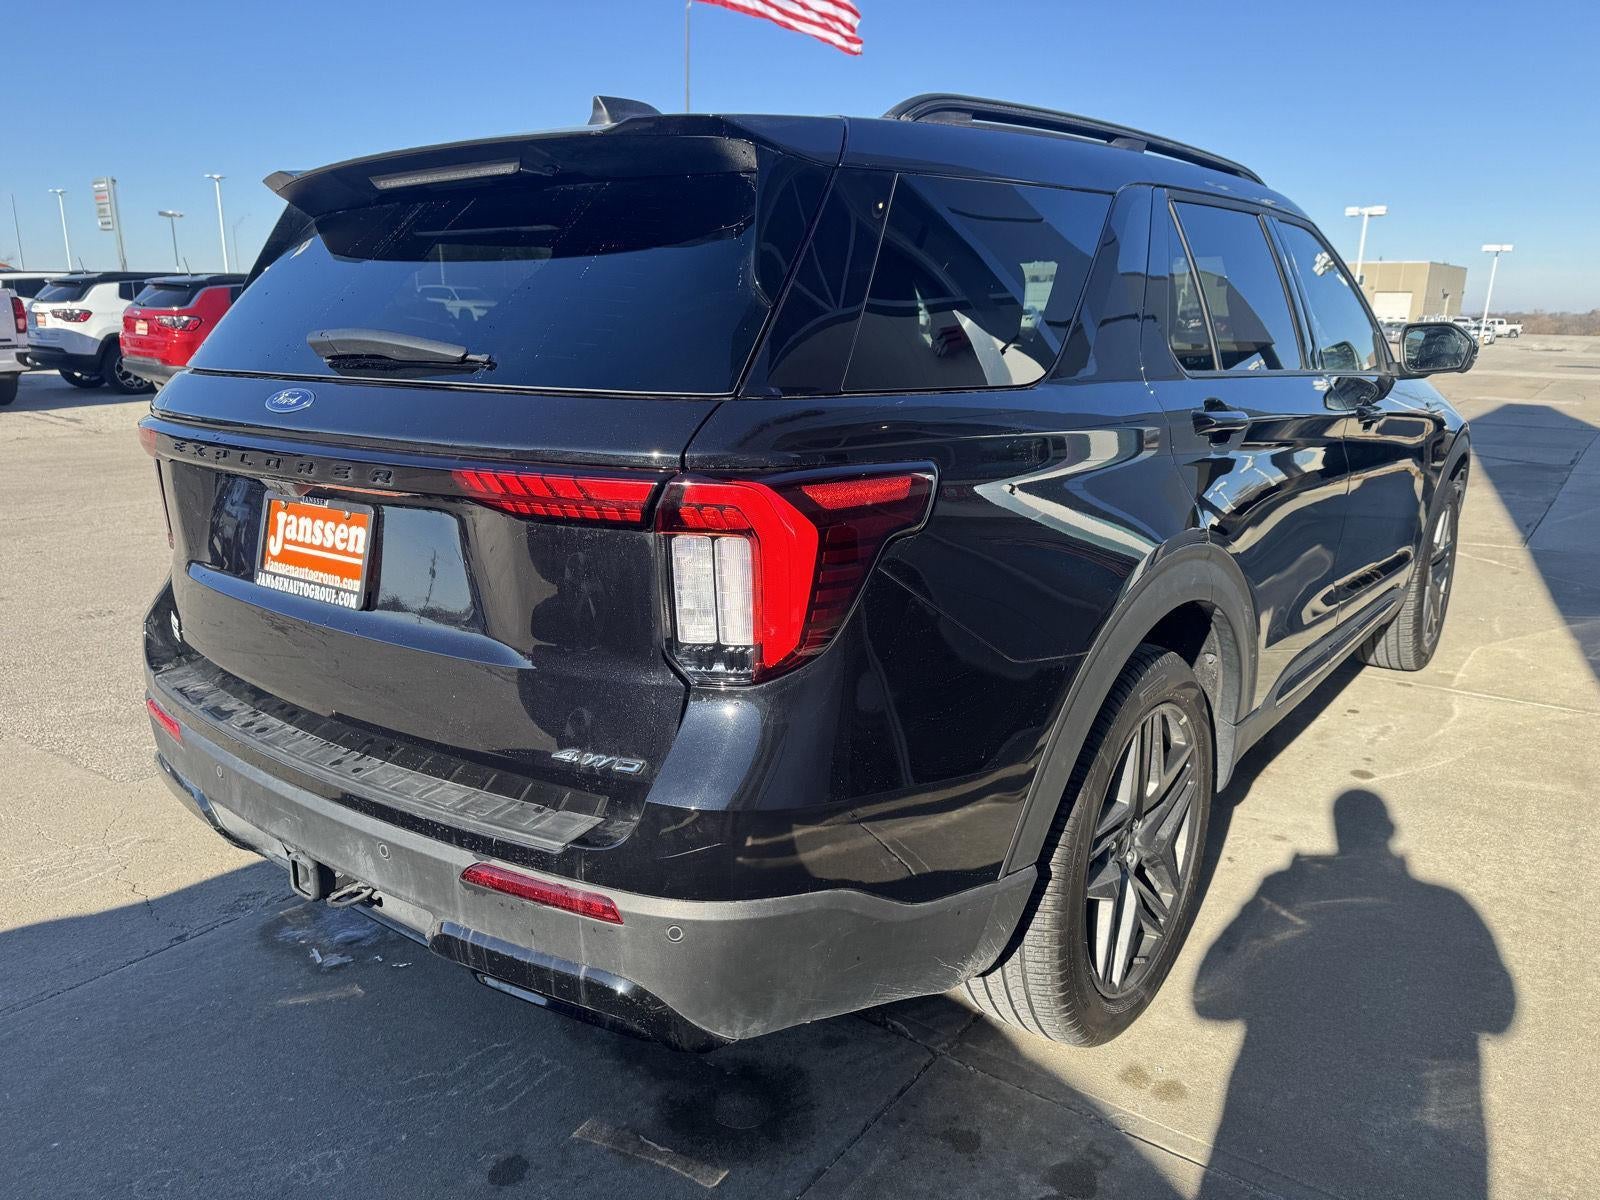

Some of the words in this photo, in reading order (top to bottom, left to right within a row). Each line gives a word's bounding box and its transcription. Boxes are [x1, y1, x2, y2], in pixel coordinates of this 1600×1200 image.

[270, 390, 306, 407] Ford
[174, 441, 394, 484] EXPLORER
[301, 496, 328, 508] JANSSEN
[551, 748, 646, 774] 4WD
